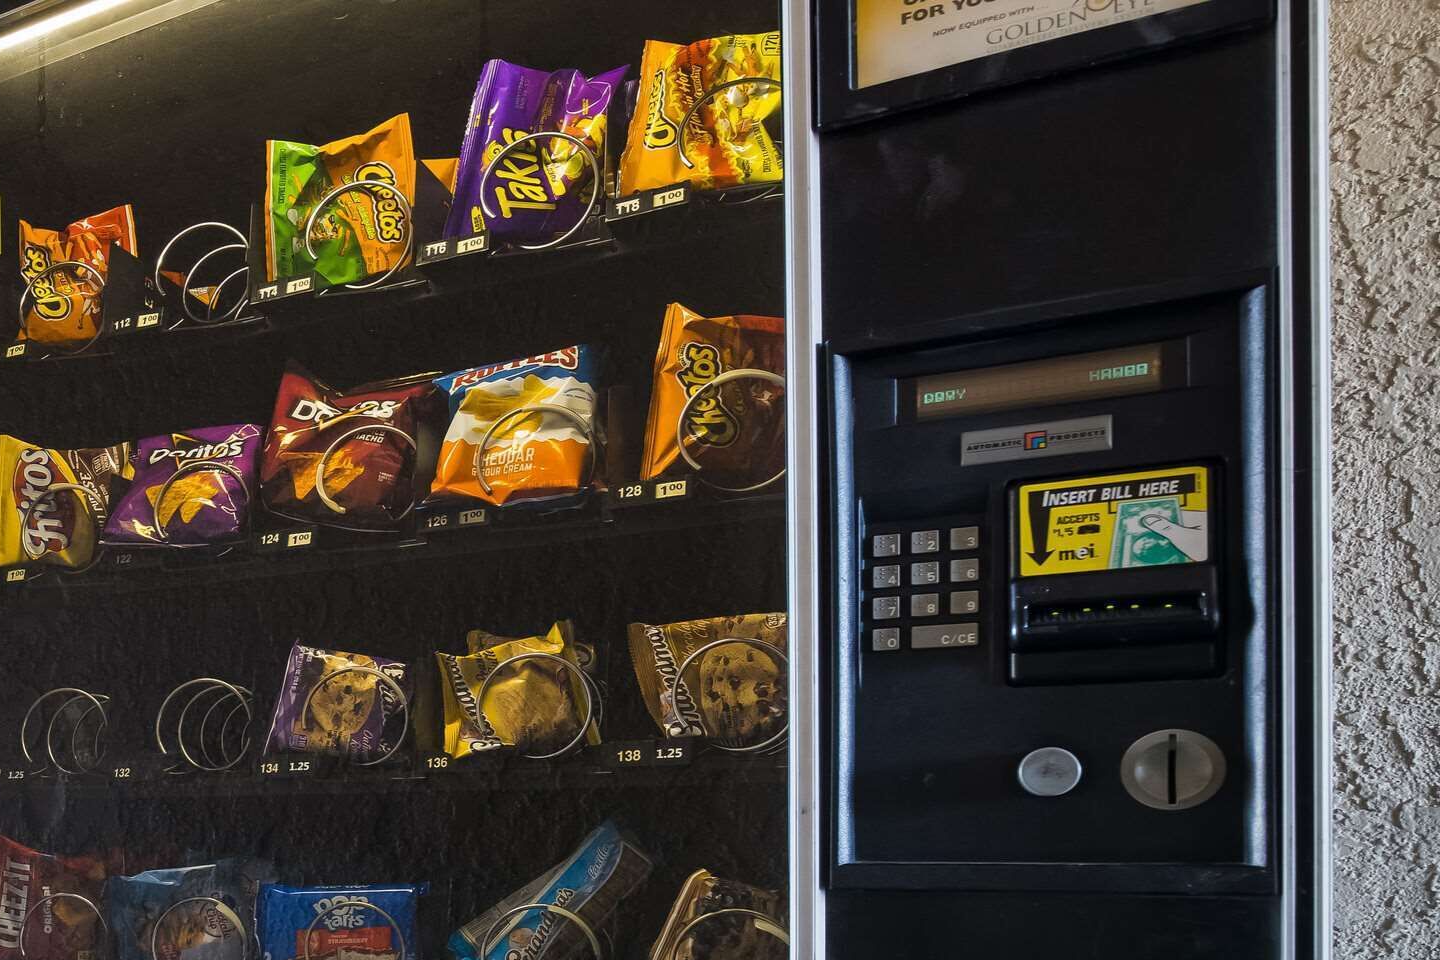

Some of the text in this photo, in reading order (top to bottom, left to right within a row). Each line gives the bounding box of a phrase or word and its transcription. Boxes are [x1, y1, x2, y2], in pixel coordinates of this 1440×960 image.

[900, 4, 945, 25] FOR
[932, 6, 1035, 37] NOW EQUIPPED WITH
[986, 7, 1087, 45] GOLDEN
[764, 34, 779, 51] 170
[643, 69, 678, 149] Cheetos
[494, 127, 557, 218] Takis
[356, 163, 404, 242] Cheetos
[22, 243, 71, 320] Cheetos
[113, 317, 131, 330] 112
[678, 343, 739, 447] Cheetos
[966, 429, 1106, 451] AUTOMATIC PRODUCTS
[149, 441, 245, 465] Doritos
[473, 448, 535, 466] CHEDDAR
[503, 464, 533, 475] CREAM
[618, 485, 642, 498] 128
[1042, 489, 1098, 507] INSERT
[1101, 485, 1133, 501] BILL
[1138, 479, 1180, 497] HERE
[17, 447, 69, 559] Fritos
[426, 515, 448, 528] 126
[1056, 512, 1101, 526] ACCEPTS
[260, 533, 280, 545] 124
[967, 537, 976, 546] 3
[889, 544, 897, 554] 1
[927, 541, 936, 551] 2
[1059, 543, 1096, 561] mei
[116, 554, 132, 564] 122
[888, 575, 896, 585] 4
[927, 572, 936, 582] 5
[967, 569, 976, 578] 6
[888, 606, 896, 616] 7
[927, 603, 936, 613] 8
[967, 601, 976, 611] 9
[941, 633, 976, 645] C/CE
[617, 747, 683, 763] 138 1.25
[260, 761, 310, 774] 134 1.25
[427, 757, 448, 769] 136
[8, 770, 24, 779] 1.25
[114, 767, 130, 778] 132
